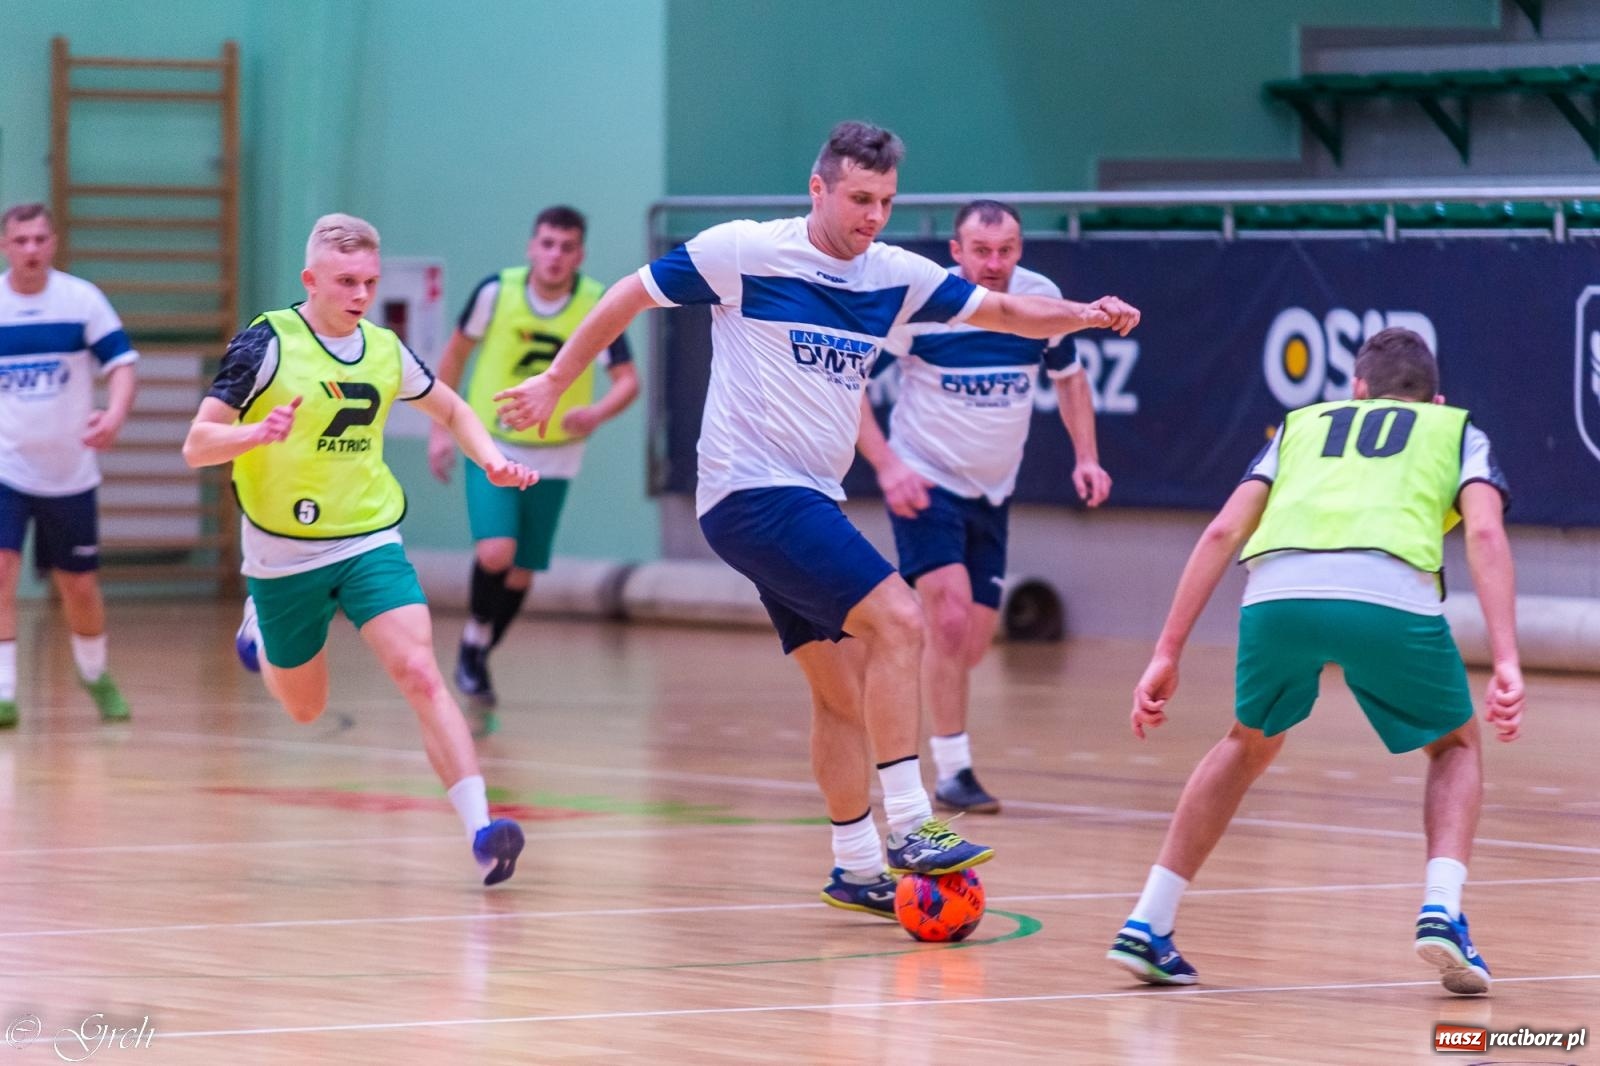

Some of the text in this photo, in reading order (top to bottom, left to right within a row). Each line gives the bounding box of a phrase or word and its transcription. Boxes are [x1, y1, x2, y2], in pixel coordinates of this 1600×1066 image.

[792, 331, 865, 354] INSTAL
[1318, 406, 1418, 458] 10
[299, 500, 316, 523] 5
